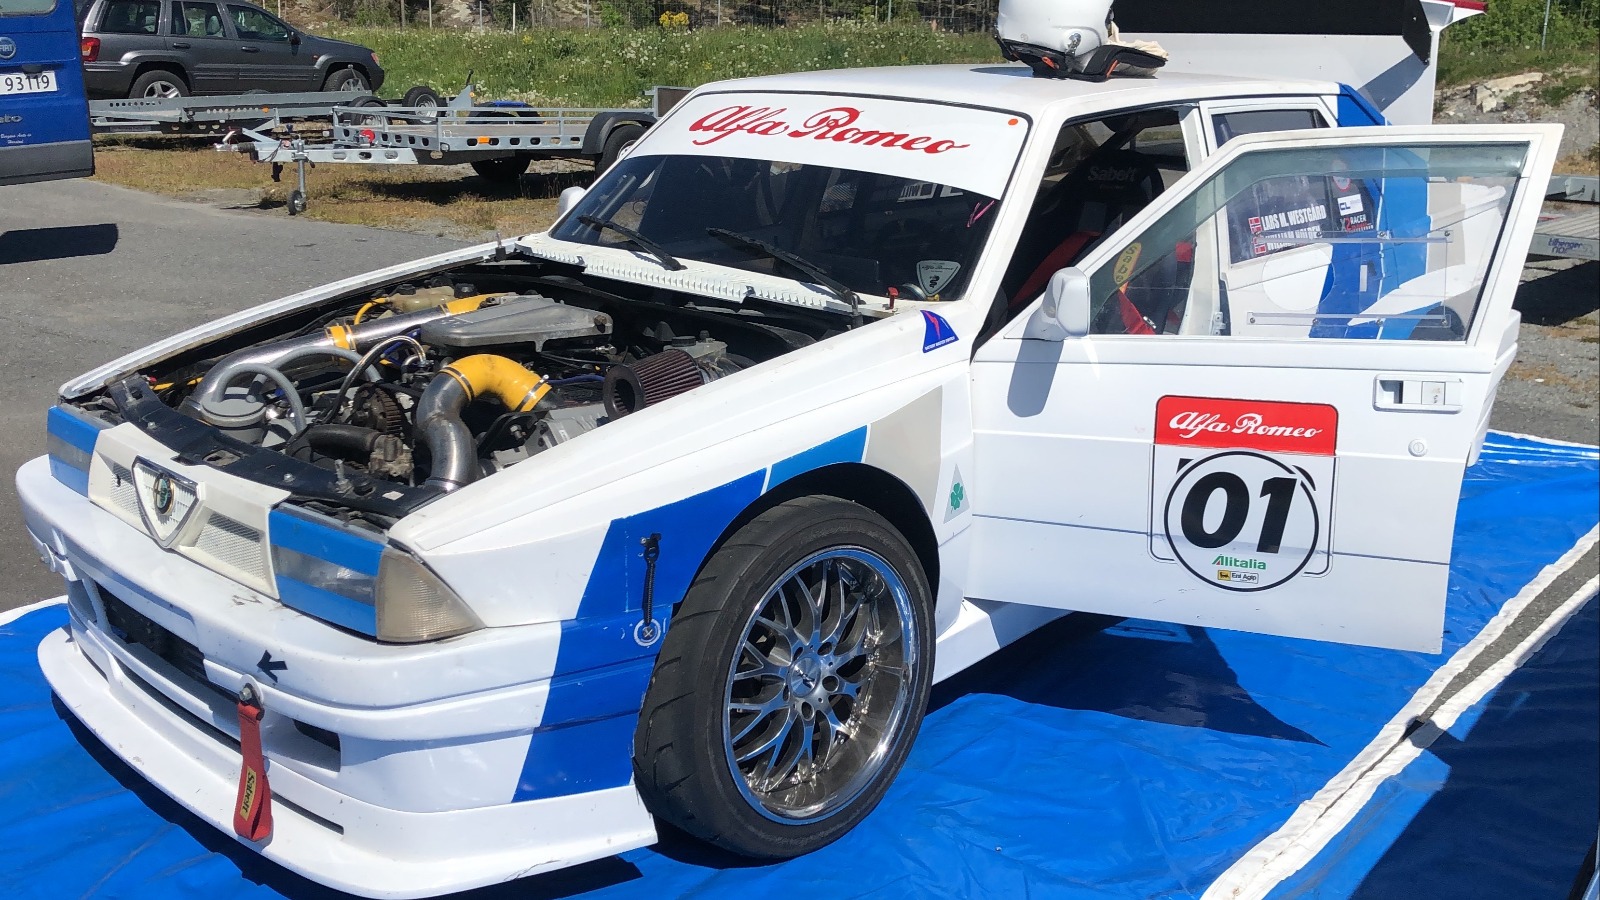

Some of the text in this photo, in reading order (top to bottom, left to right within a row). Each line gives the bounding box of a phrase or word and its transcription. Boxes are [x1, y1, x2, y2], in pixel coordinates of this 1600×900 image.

[5, 74, 50, 91] 93119
[688, 105, 971, 154] Alfa Romeo
[1261, 213, 1280, 231] LARS
[1168, 411, 1324, 438] Alfa Romeo
[1181, 471, 1298, 554] 01
[1212, 554, 1267, 570] Alitalia
